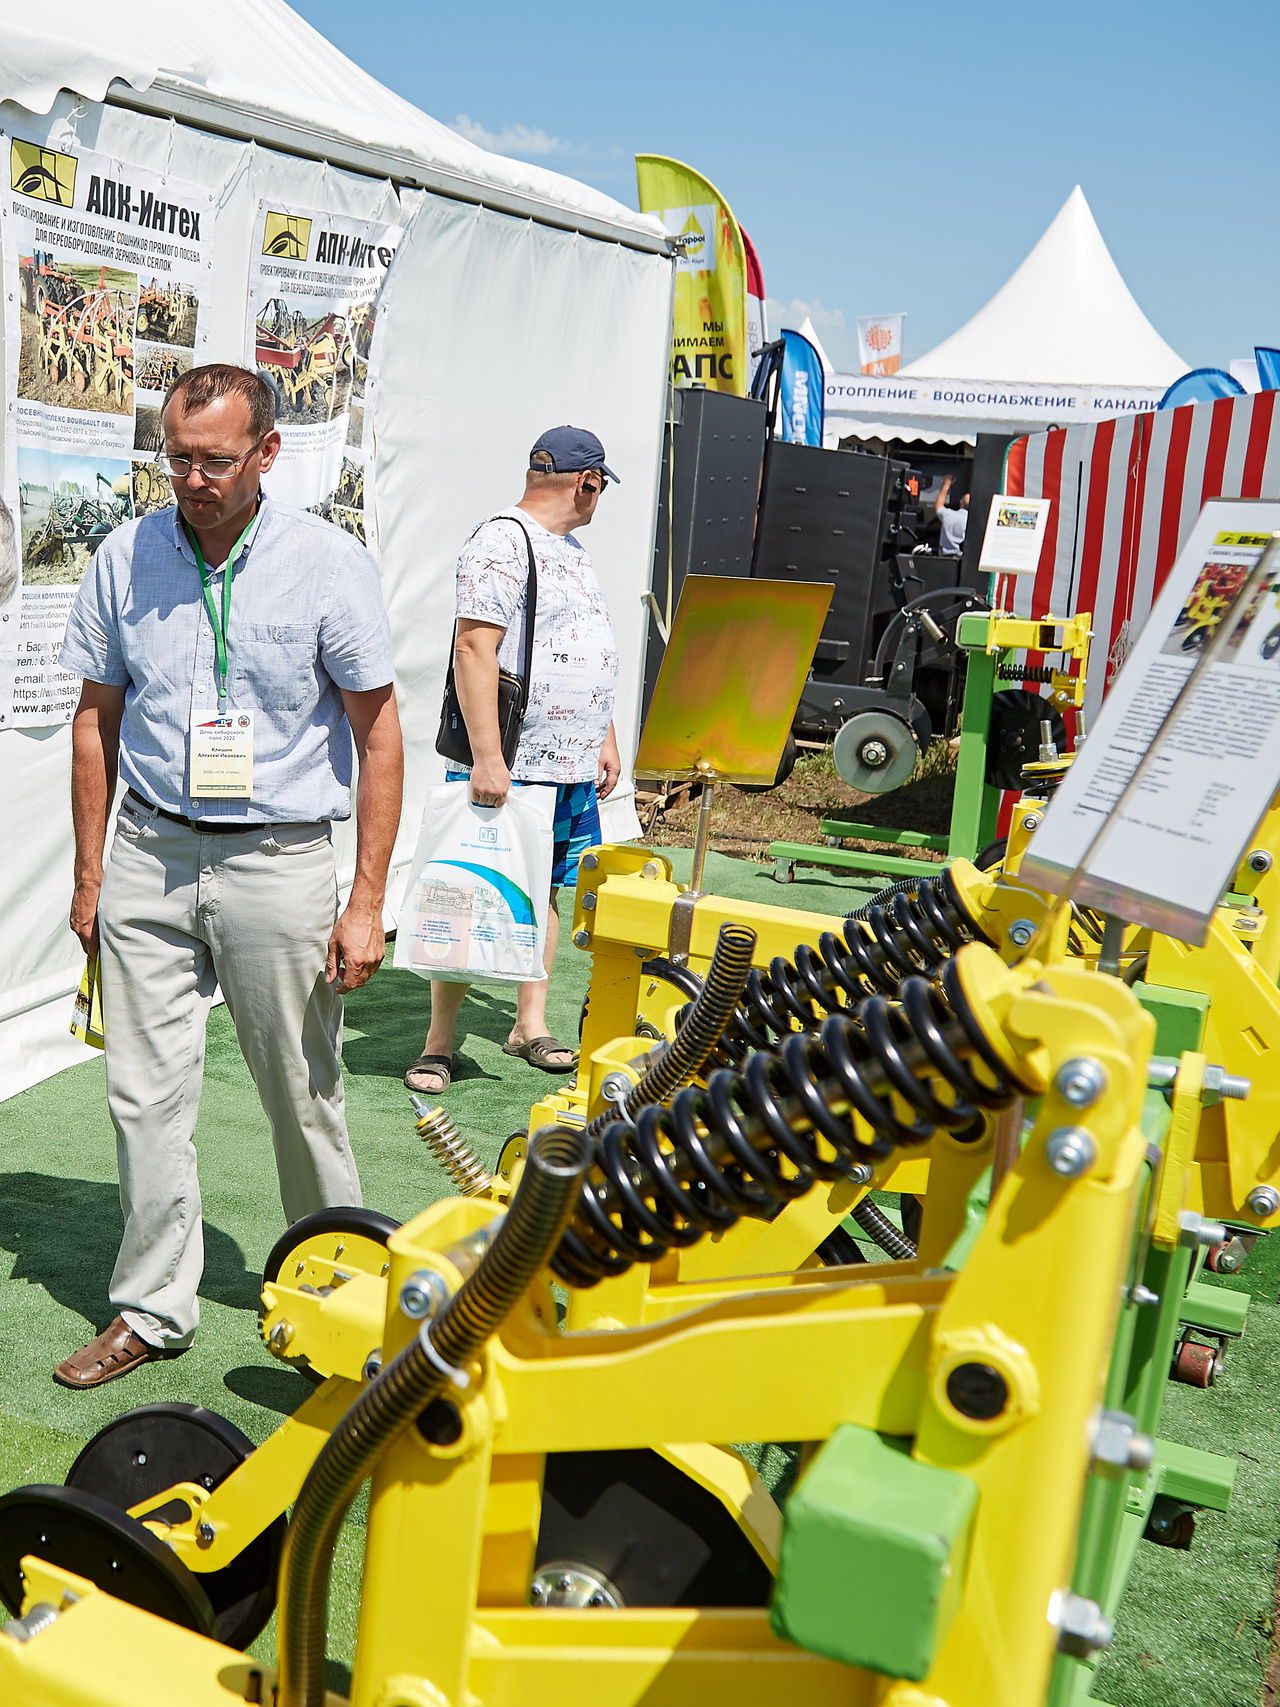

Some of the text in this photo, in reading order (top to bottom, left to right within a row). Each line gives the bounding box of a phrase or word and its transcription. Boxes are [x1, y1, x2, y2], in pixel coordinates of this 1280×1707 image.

[86, 174, 202, 241] АПК-Интех
[13, 201, 60, 229] ПРОЕКТИРОВАНИЕ
[67, 219, 116, 243] ИЗГОТОВЛЕНИЕ
[117, 231, 148, 251] СОШНИКОВ
[149, 240, 179, 257] ПРЯМОГО
[179, 246, 201, 263] ПОСЕВА
[679, 236, 705, 244] rapool
[35, 227, 172, 272] ДЛЯ ПЕРЕОБОРУДОВАНИЯ ЗЕРНОВЫХ СЕЯЛОК
[260, 264, 298, 280] ПРОЕКТИРОВАНИЕ
[703, 322, 723, 332] МЫ
[673, 353, 733, 379] АПС
[826, 385, 917, 399] ОТОПЛЕНИЕ
[933, 390, 1076, 407] ВОДОСНАБЖЕНИЕ
[67, 416, 100, 427] BOURGAULT
[17, 658, 38, 666] тел.:
[552, 653, 568, 663] 76
[14, 673, 46, 684] e-mail:
[541, 750, 555, 760] 76
